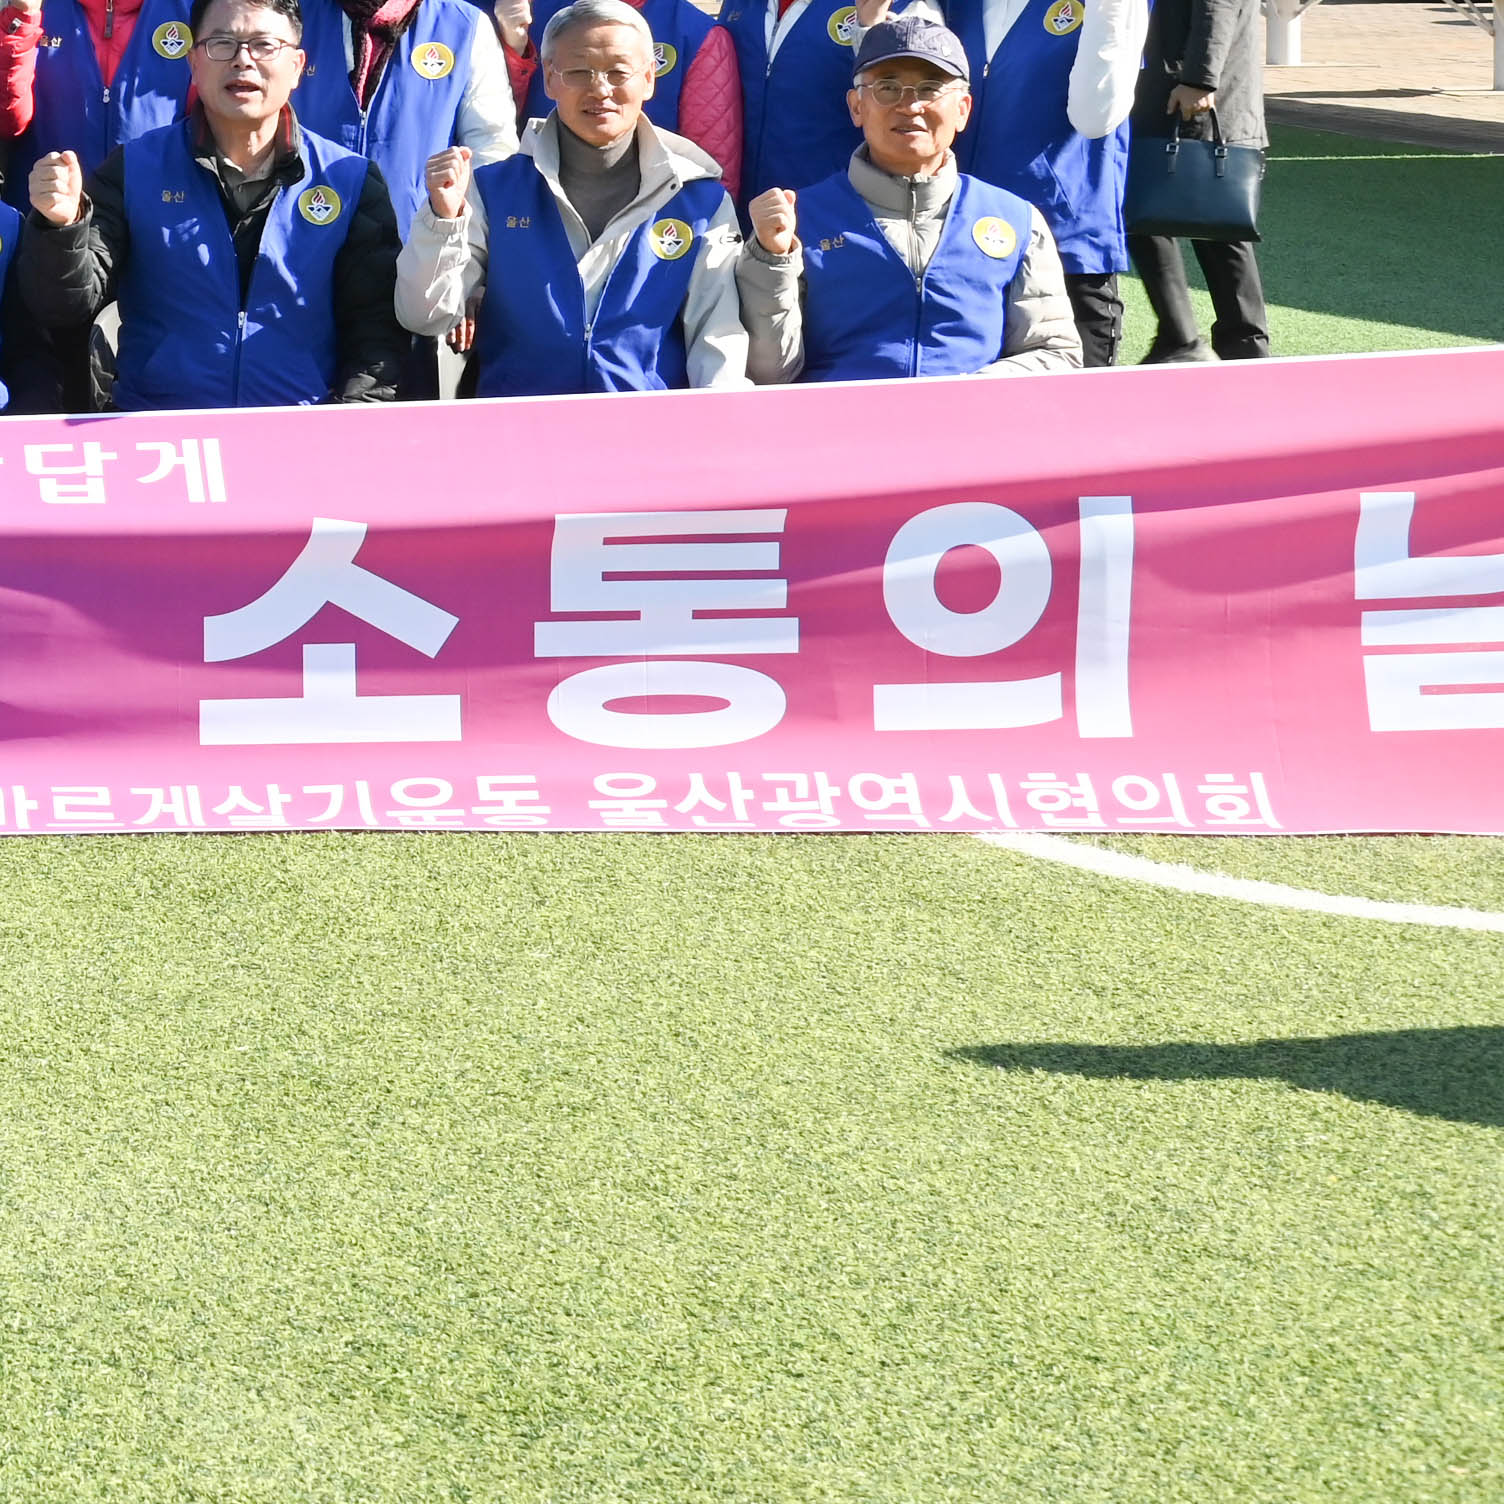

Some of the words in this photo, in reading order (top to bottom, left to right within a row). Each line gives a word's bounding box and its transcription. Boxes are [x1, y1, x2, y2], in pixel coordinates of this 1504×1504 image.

[161, 189, 185, 203] 울산
[506, 215, 530, 229] 울산
[820, 234, 845, 251] 울산
[199, 496, 1134, 750] 소통의
[588, 770, 1284, 829] 울산광역시협의회
